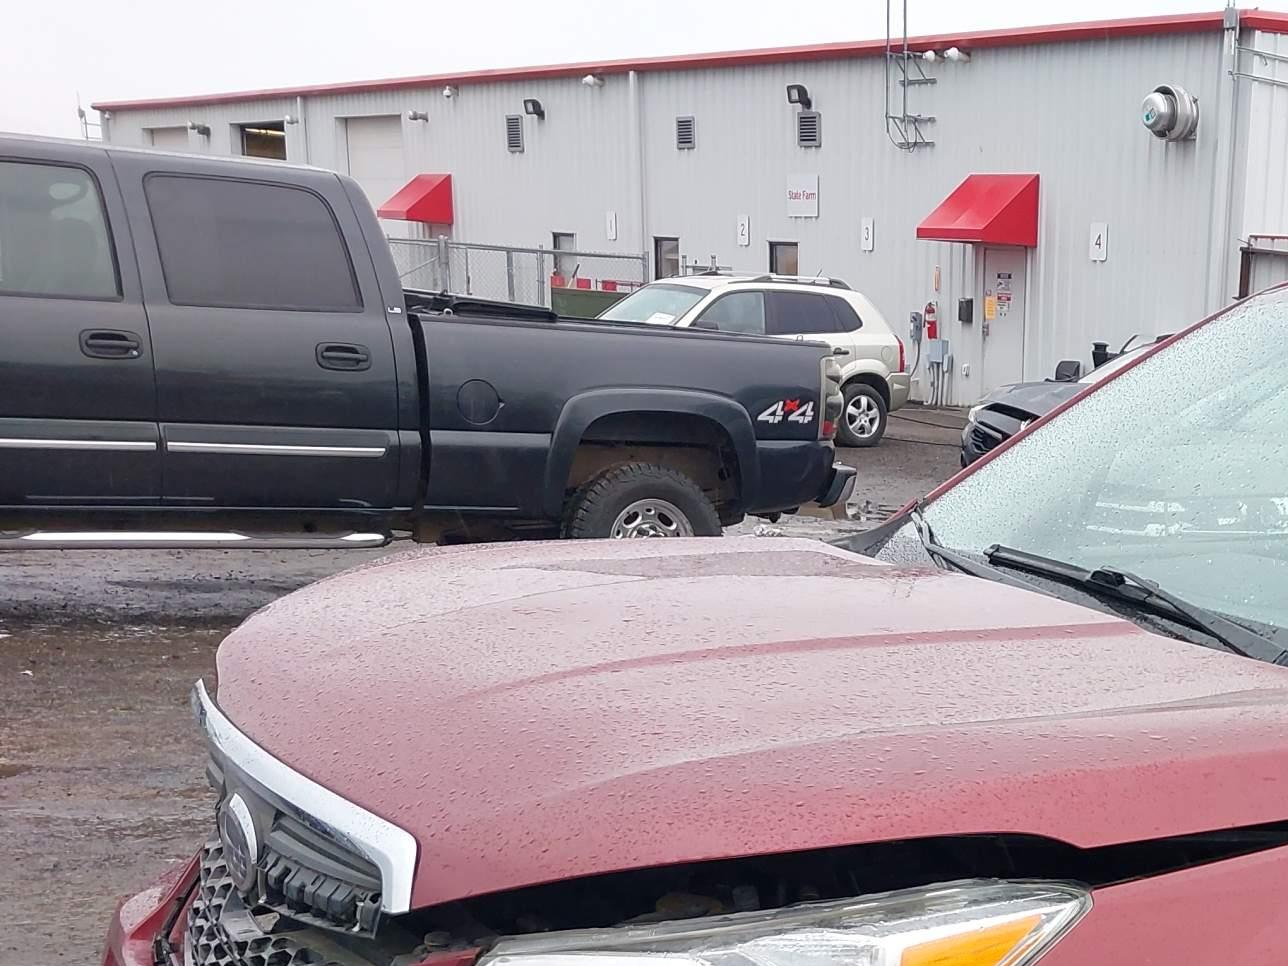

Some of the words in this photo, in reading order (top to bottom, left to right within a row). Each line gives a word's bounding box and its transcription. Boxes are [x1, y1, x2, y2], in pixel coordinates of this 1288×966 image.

[788, 190, 801, 201] State
[802, 190, 816, 201] Farm
[740, 223, 745, 236] 2
[864, 226, 869, 241] 3
[1095, 233, 1102, 249] 4
